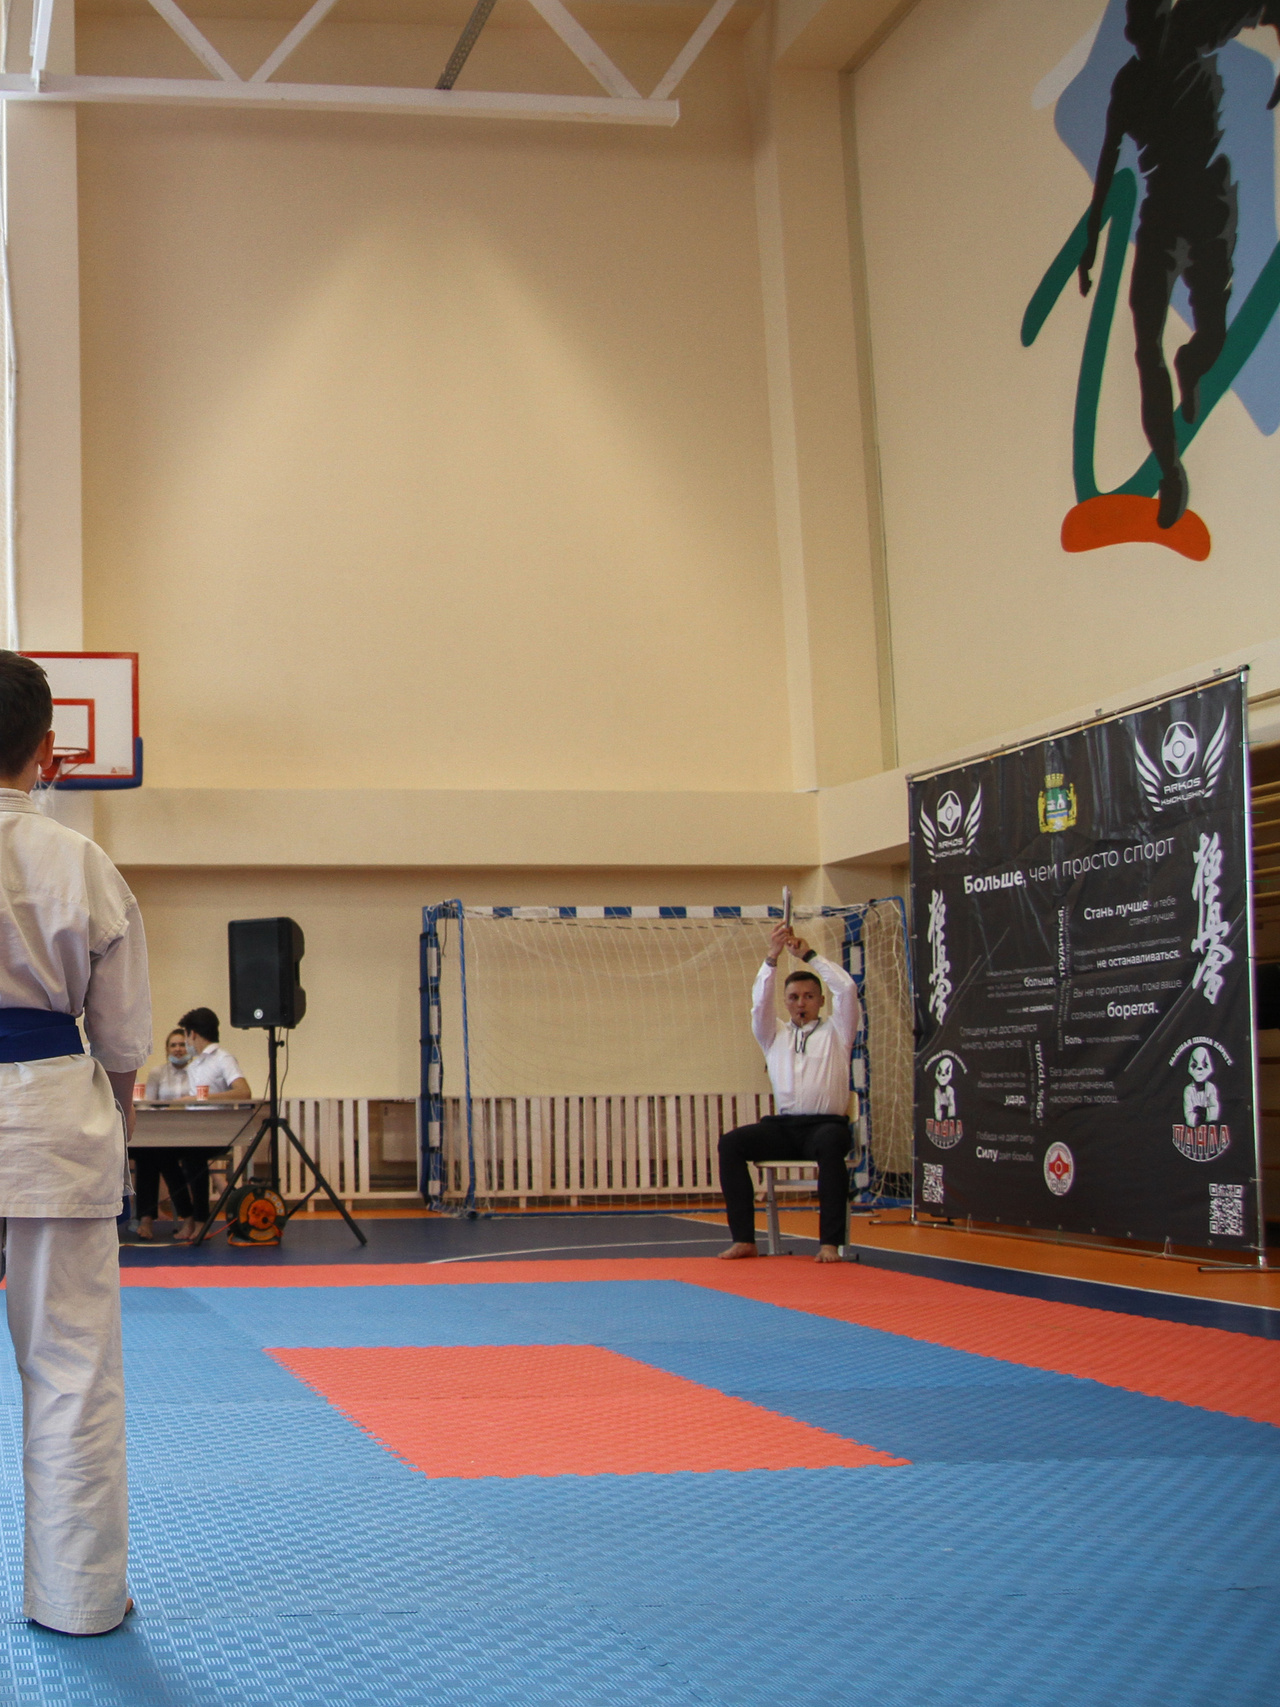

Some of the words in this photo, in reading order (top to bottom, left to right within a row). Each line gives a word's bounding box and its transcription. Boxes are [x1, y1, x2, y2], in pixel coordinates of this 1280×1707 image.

[1163, 777, 1201, 795] ARKOS
[963, 870, 1027, 895] Больше,
[1029, 863, 1058, 882] чем
[1062, 850, 1119, 879] просто
[1124, 837, 1175, 863] спорт
[1083, 906, 1114, 921] Стань
[1115, 900, 1149, 918] лучше
[1159, 895, 1176, 907] тебе
[1096, 959, 1106, 969] не
[1023, 976, 1056, 988] больше,
[1072, 987, 1084, 998] Вы
[1085, 988, 1094, 997] не
[1095, 983, 1141, 998] проиграли,
[1142, 981, 1160, 992] пока
[1160, 979, 1182, 990] ваше
[1106, 1001, 1160, 1020] борется.
[1034, 1040, 1046, 1086] труда.
[1003, 1095, 1026, 1106] удар.
[1035, 1089, 1045, 1119] 99%
[975, 1146, 998, 1162] Силу
